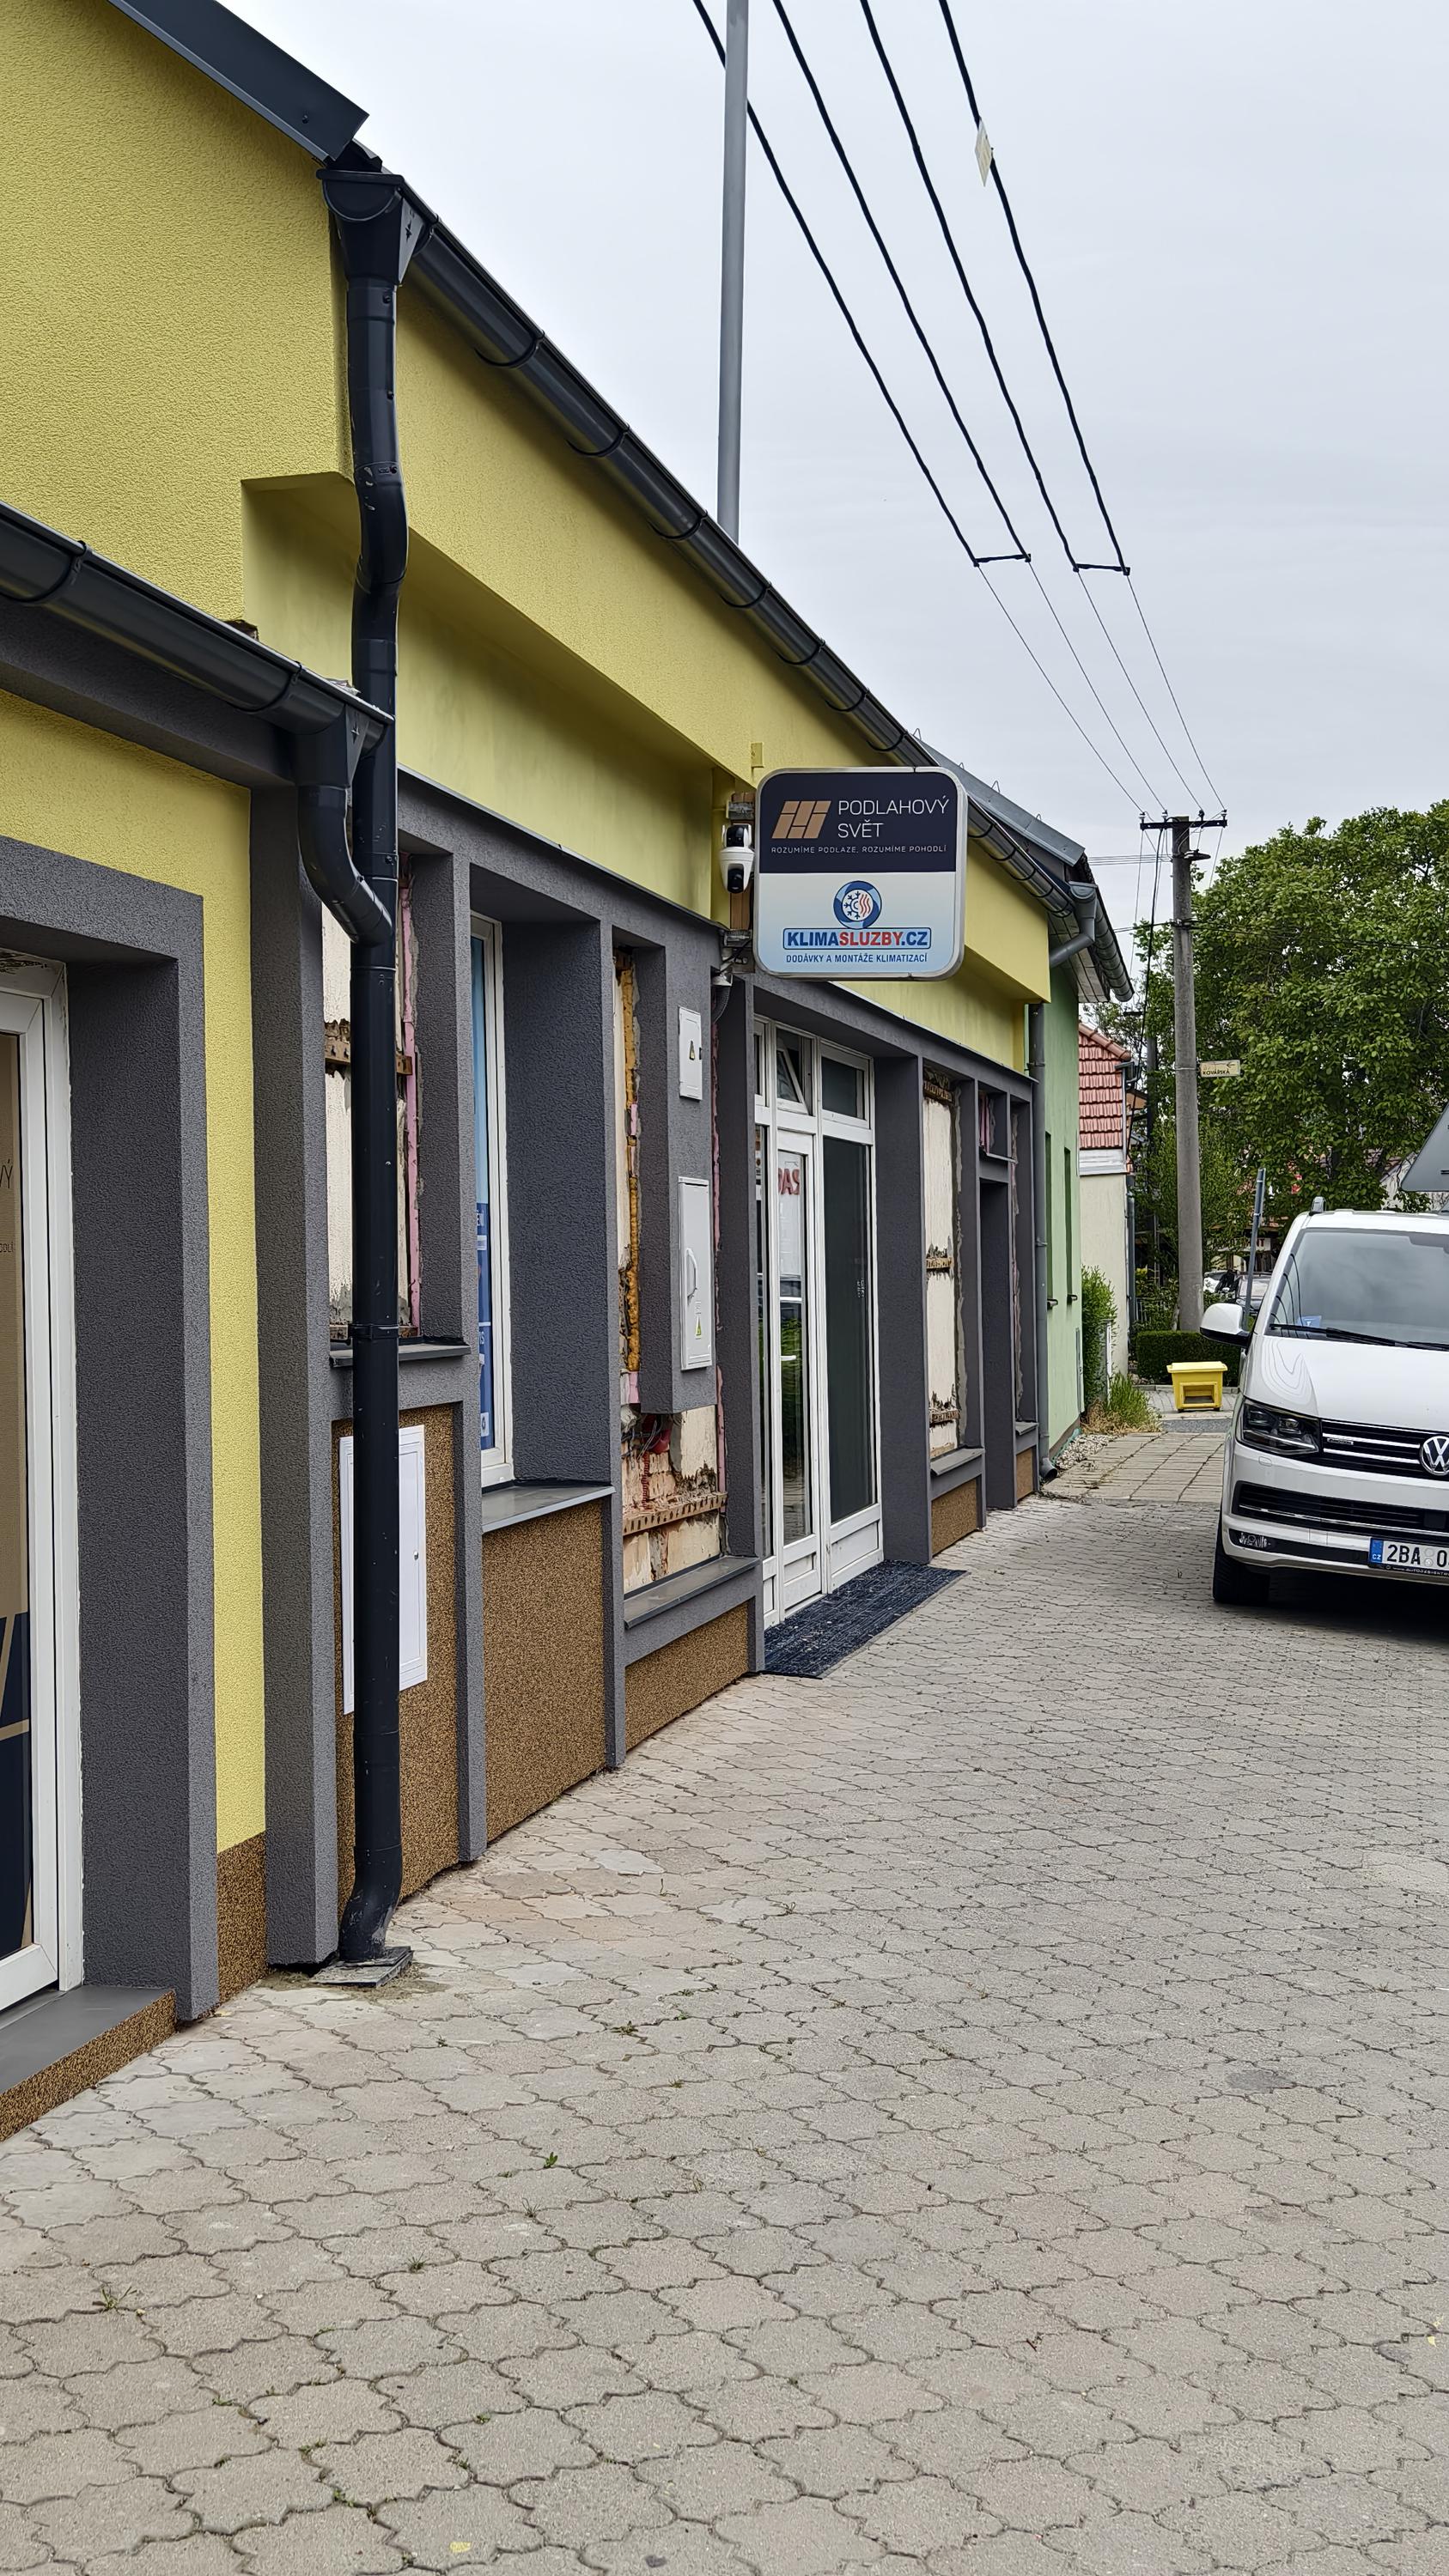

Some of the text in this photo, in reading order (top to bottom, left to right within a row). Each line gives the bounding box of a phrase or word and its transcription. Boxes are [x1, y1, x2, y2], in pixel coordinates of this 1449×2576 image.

[837, 795, 950, 816] PODLAHOVÝ
[837, 818, 885, 839] SVĚT
[770, 845, 816, 854] ROZUMÍME
[861, 844, 906, 854] ROZUMÍME
[909, 843, 947, 854] POHODLÍ
[787, 931, 928, 947] KLIMASLUZBY.CZ
[785, 952, 928, 963] DODÁVKY A MONTÁŽE KLIMATIZACÍ
[1386, 1544, 1449, 1568] 2BA 0
